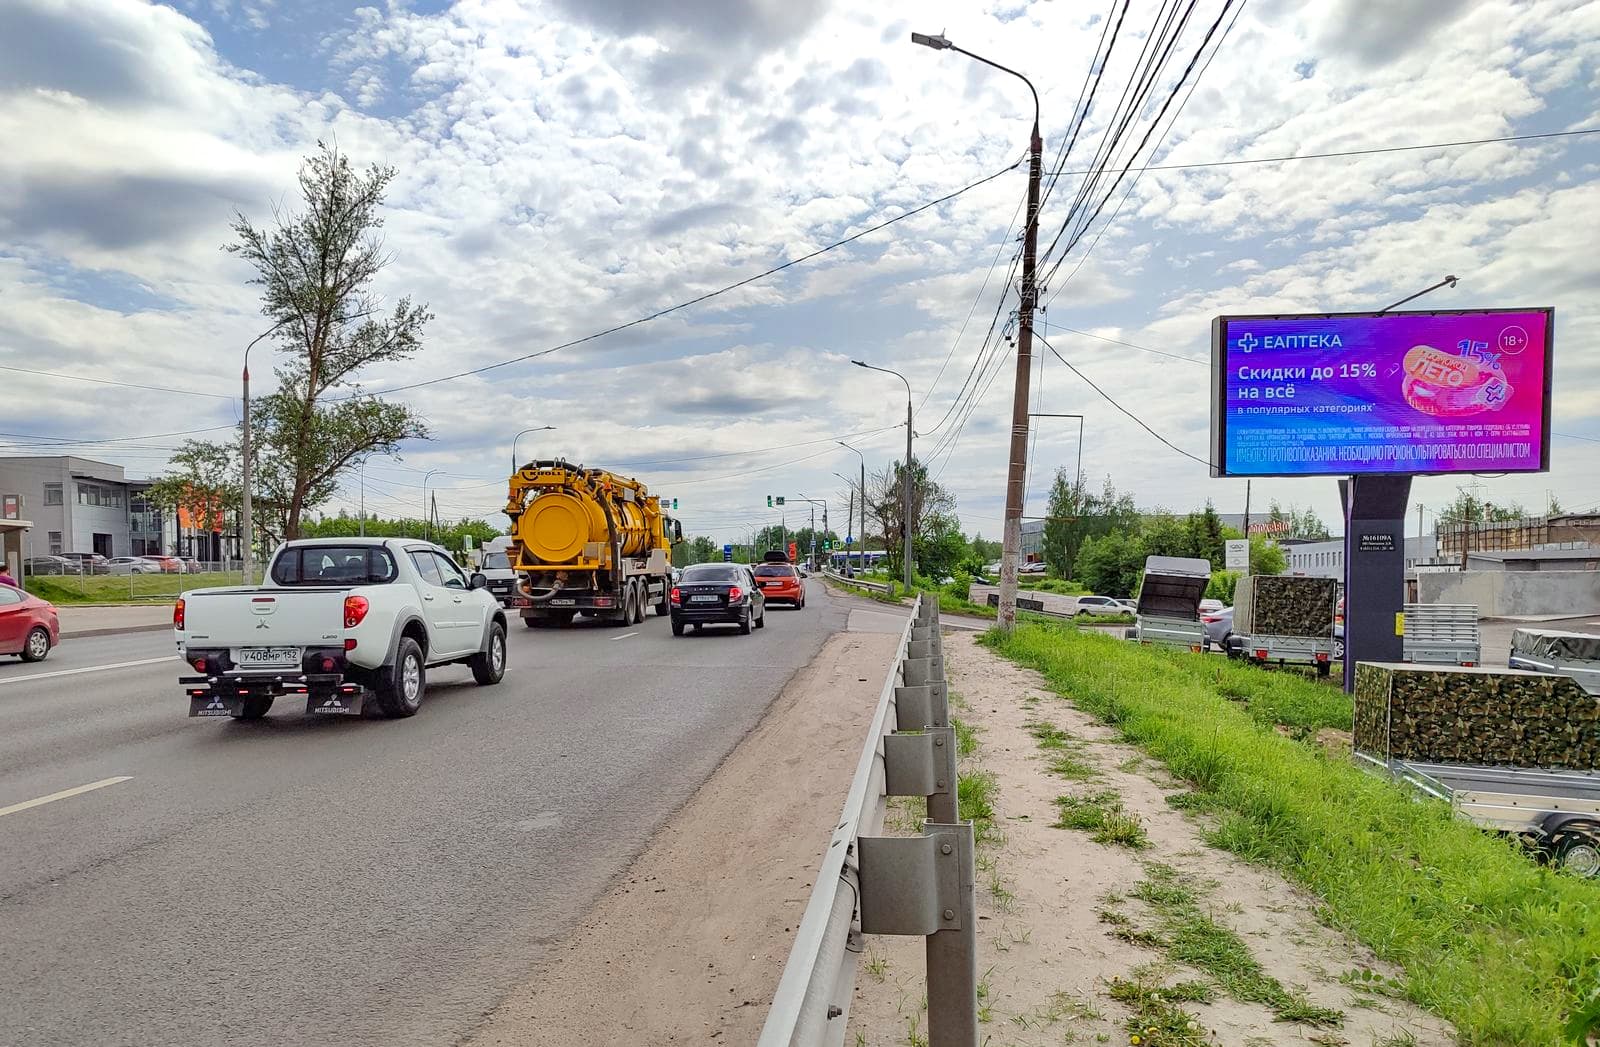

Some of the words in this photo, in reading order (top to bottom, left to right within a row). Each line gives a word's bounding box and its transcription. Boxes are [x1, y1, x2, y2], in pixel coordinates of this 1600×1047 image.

[1264, 334, 1343, 349] ЕАПТЕКА
[1503, 336, 1524, 347] 18+
[1238, 366, 1306, 381] Скидки
[1310, 366, 1334, 381] до
[1339, 363, 1377, 378] 15%
[1238, 387, 1259, 399] на
[1265, 384, 1295, 399] всё
[1247, 405, 1310, 416] популярных
[1339, 445, 1384, 464] НЕОБХОДИМО
[1477, 443, 1531, 461] СПЕЦИАЛИСТОМ
[283, 651, 297, 659] 152
